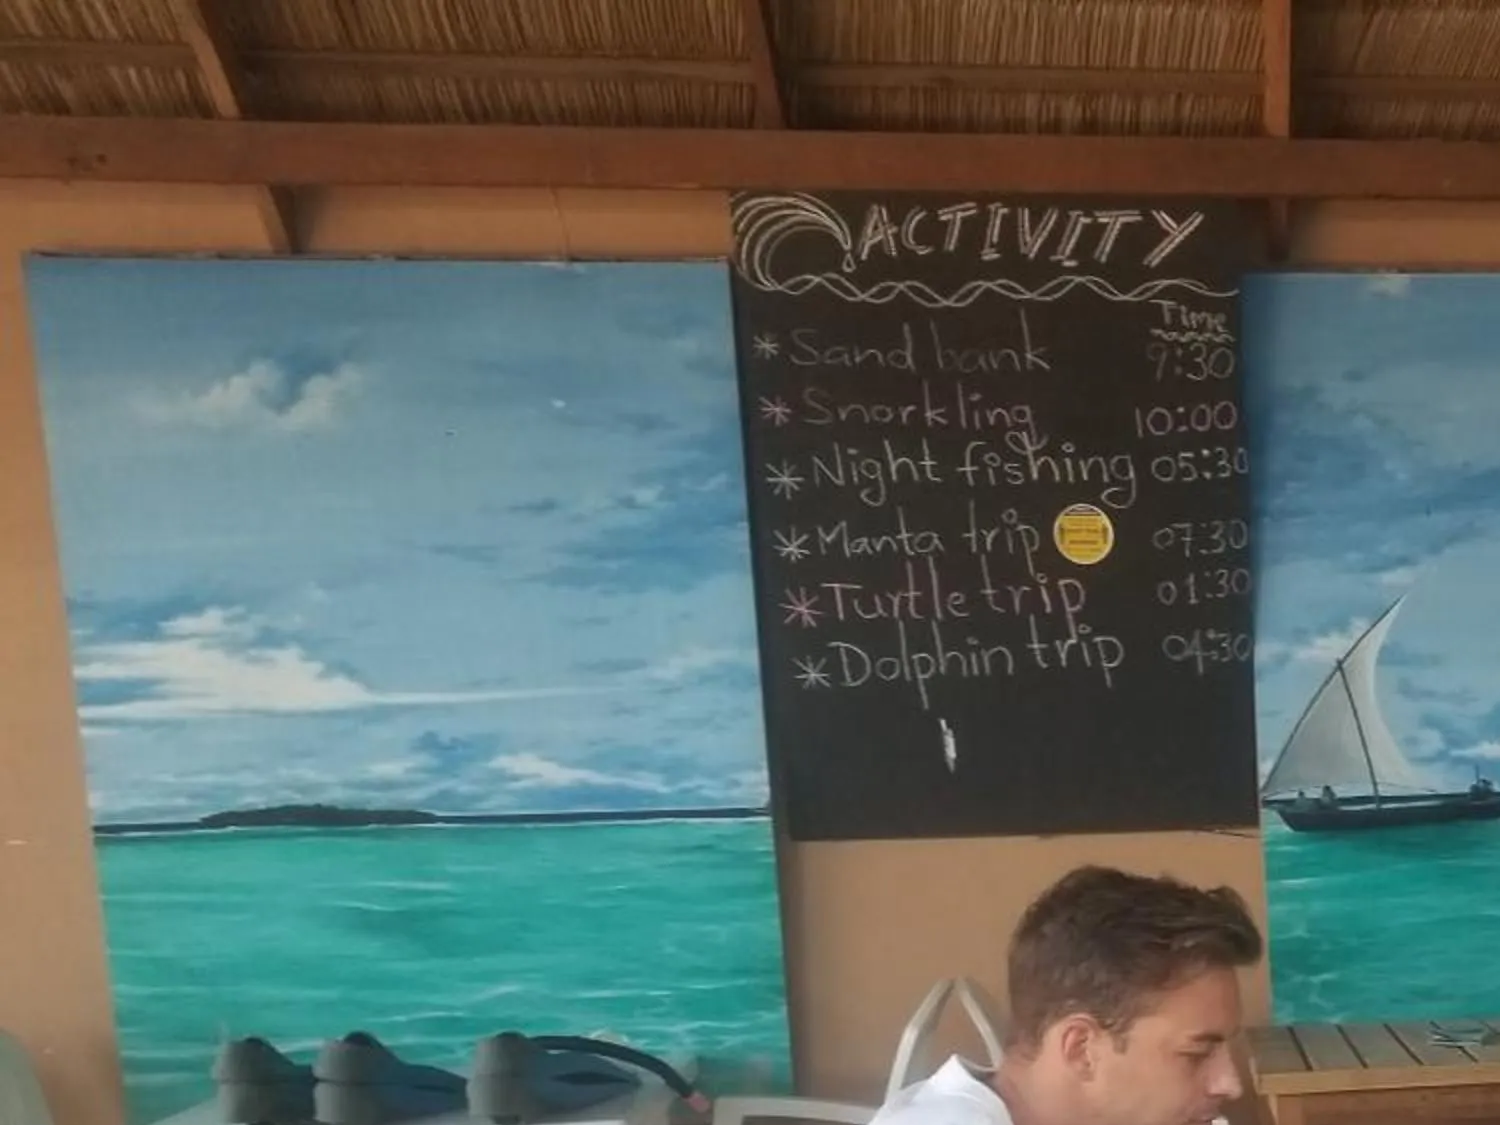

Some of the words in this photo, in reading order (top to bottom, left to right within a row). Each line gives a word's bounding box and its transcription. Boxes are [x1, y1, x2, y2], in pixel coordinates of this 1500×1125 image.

[856, 202, 1204, 268] ACTIVITY
[788, 322, 916, 371] Sand
[930, 308, 1052, 371] bank
[1146, 342, 1235, 381] 9:30
[1148, 299, 1228, 333] Time
[803, 379, 1048, 456] Snorkling
[1135, 400, 1238, 438] 10:00
[811, 436, 943, 507] Night
[955, 438, 1137, 509] fishing
[1151, 447, 1250, 482] 05:30
[817, 504, 944, 557] Manta
[963, 500, 1040, 577] trip
[1151, 520, 1249, 558] 07:30
[820, 556, 970, 622] Turtle
[981, 554, 1086, 641] trip
[1156, 568, 1252, 605] 01:30
[827, 620, 1014, 710] Dolphin
[1028, 614, 1126, 689] trip
[1161, 628, 1253, 676] 04:30
